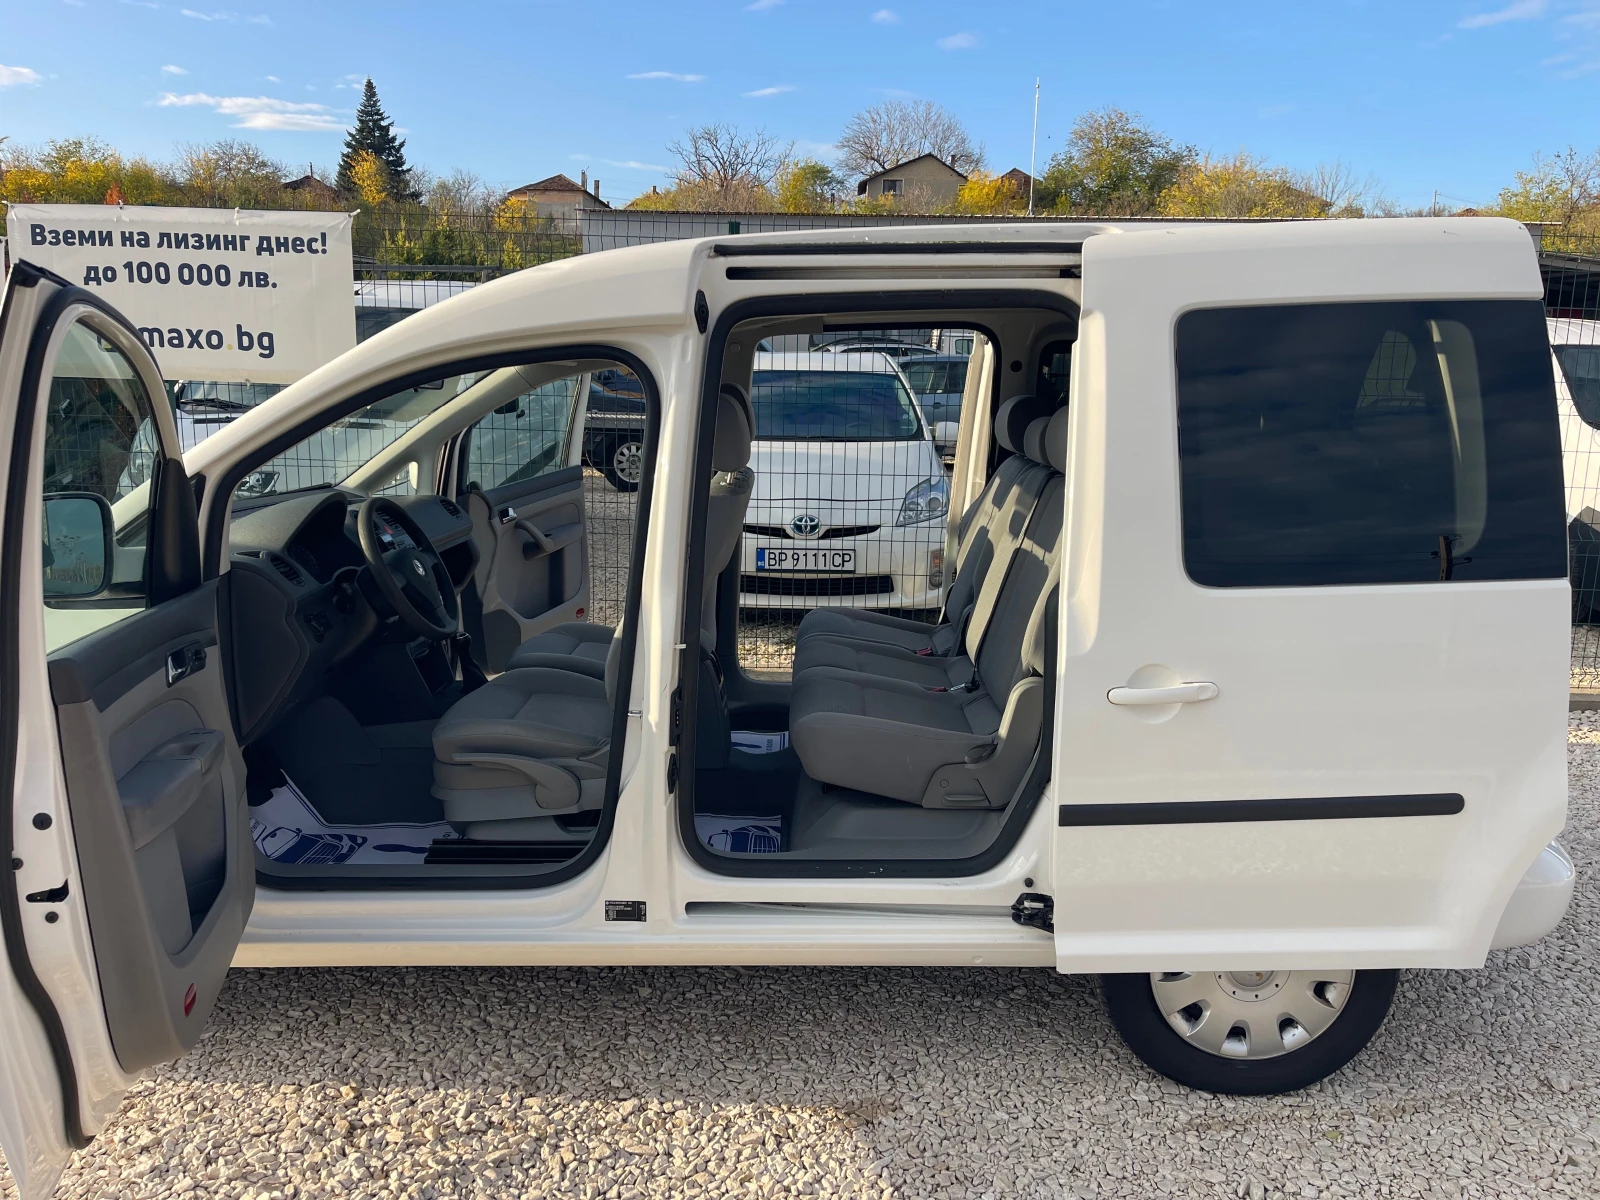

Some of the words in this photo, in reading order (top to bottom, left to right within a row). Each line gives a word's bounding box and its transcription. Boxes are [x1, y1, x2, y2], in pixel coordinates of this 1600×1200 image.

[30, 223, 114, 247] Вземи
[120, 231, 151, 248] на
[156, 232, 250, 252] лизинг
[255, 232, 328, 256] днес!
[83, 265, 117, 286] до
[122, 261, 171, 285] 100
[177, 263, 231, 287] 000
[238, 271, 278, 289] лв.
